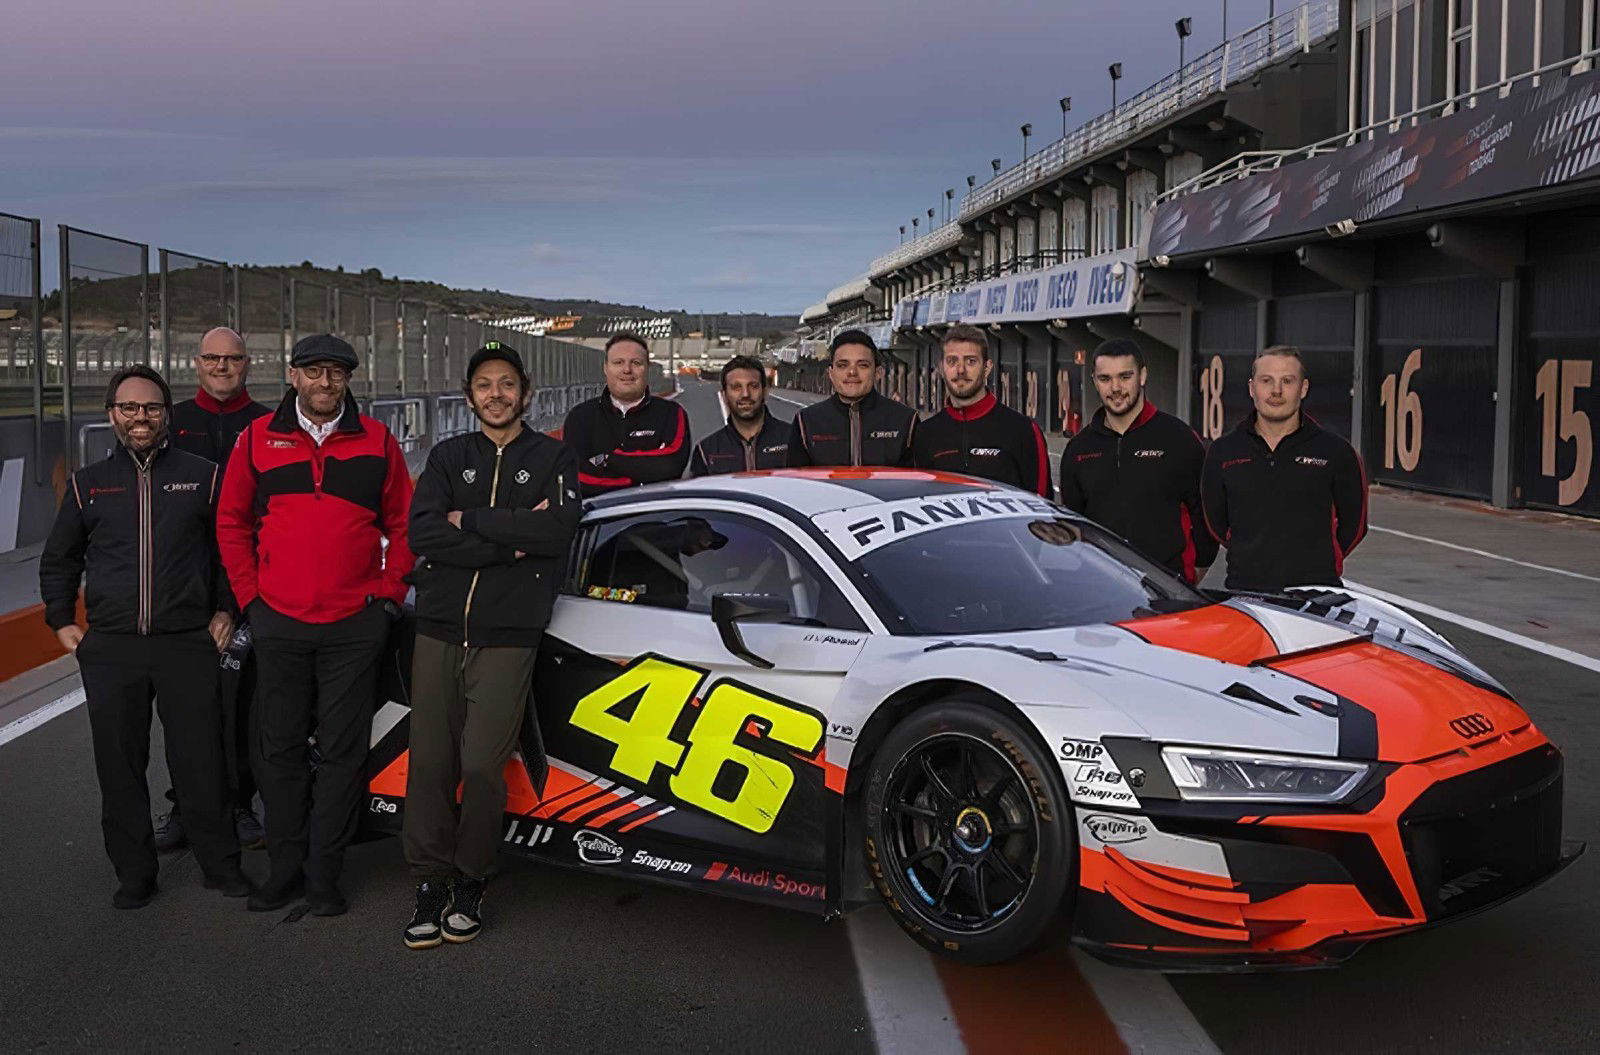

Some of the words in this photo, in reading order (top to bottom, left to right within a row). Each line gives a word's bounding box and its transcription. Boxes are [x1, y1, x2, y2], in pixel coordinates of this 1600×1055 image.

[1200, 354, 1224, 441] 18
[1380, 348, 1422, 472] 16
[1535, 359, 1593, 506] 15
[568, 656, 826, 835] 46
[1060, 742, 1103, 759] OMP
[727, 866, 770, 887] Audi
